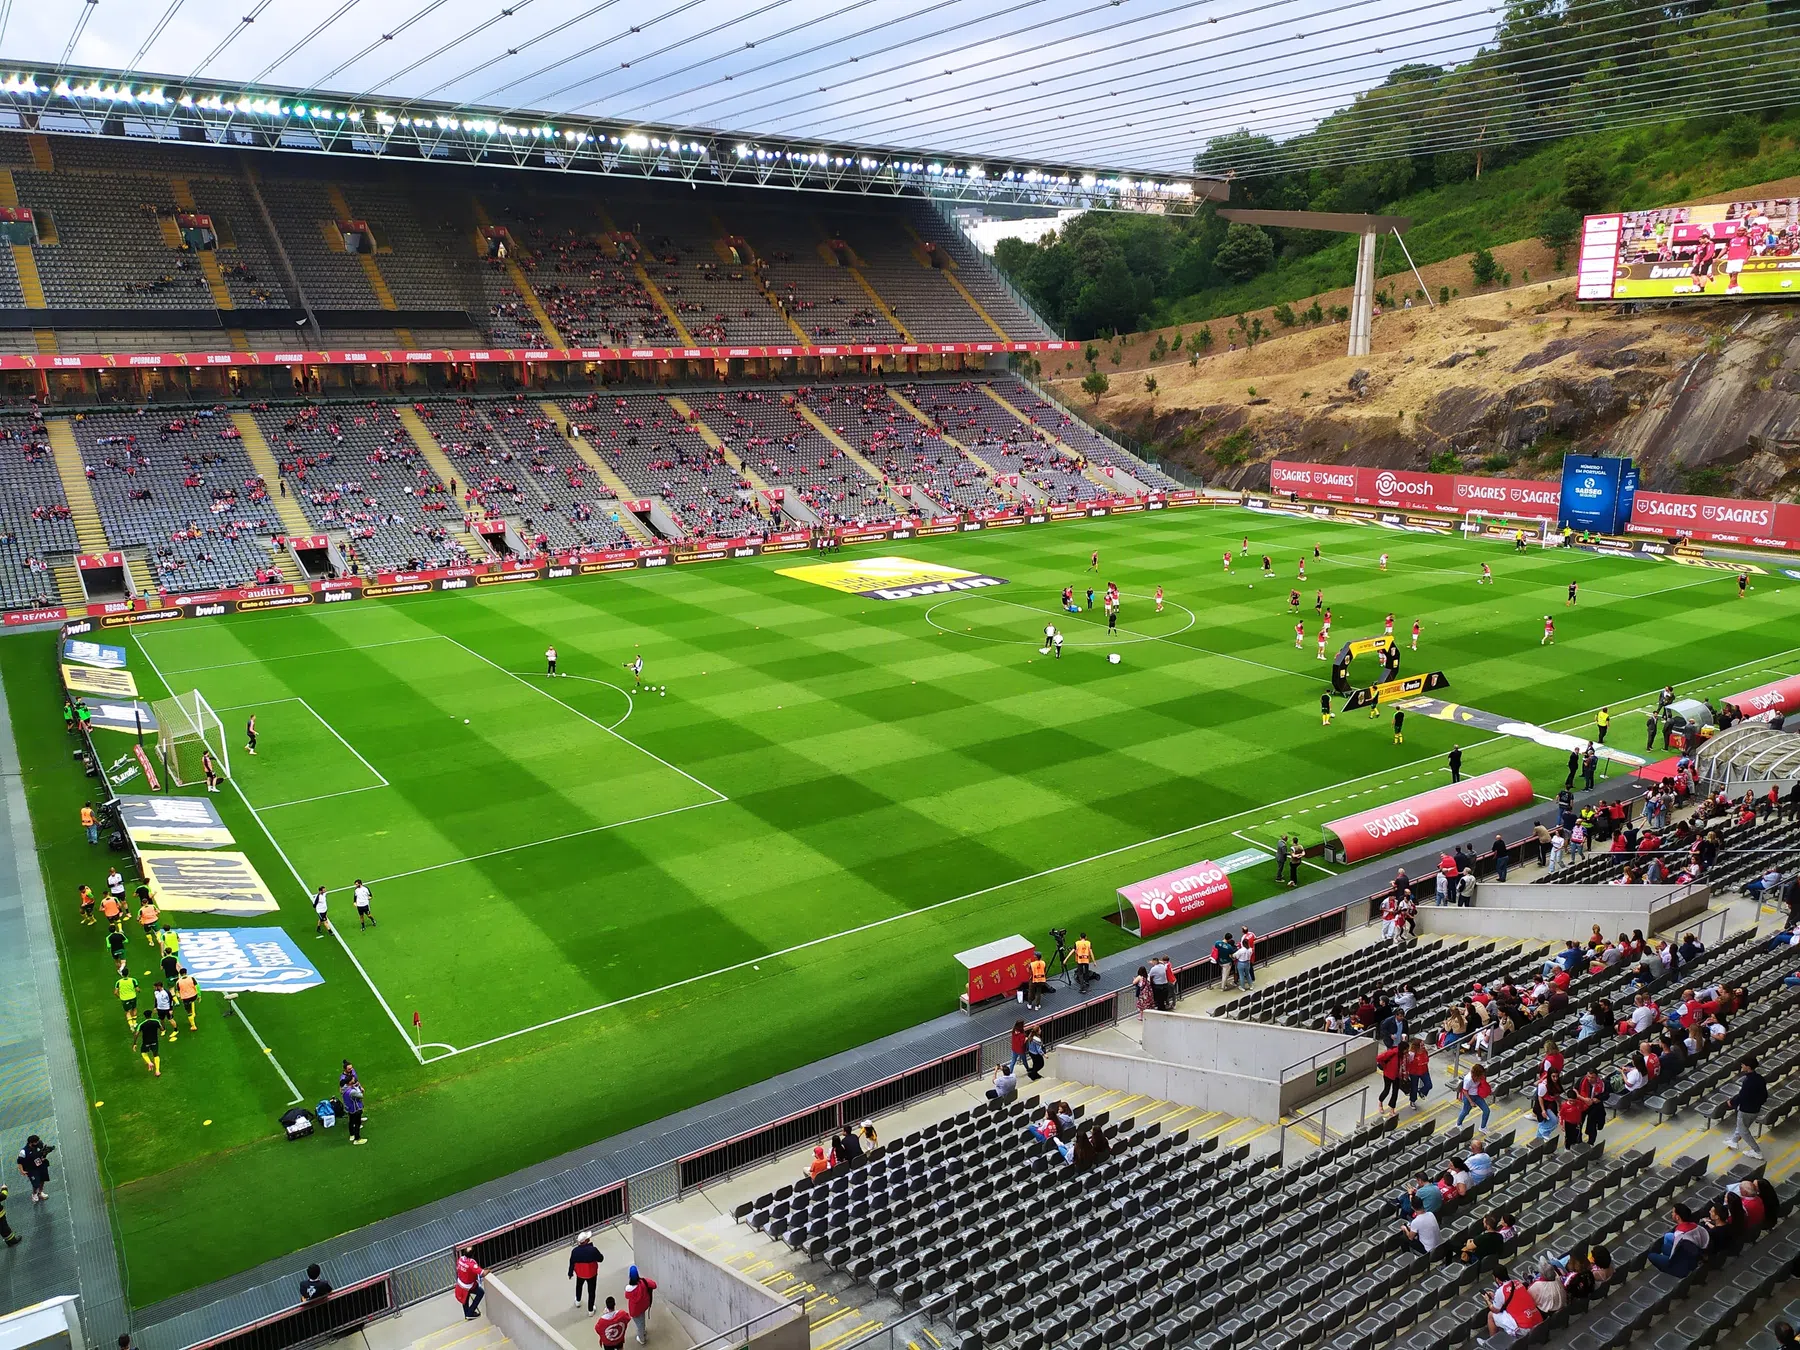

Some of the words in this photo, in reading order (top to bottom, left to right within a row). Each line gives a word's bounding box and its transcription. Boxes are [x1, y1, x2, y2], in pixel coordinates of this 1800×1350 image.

[1281, 469, 1311, 483] SAGRES
[1322, 472, 1354, 487] SAGRES
[1468, 485, 1507, 501] SAGRES
[1649, 500, 1698, 518] SAGRES
[1716, 505, 1769, 526] SAGRES
[735, 546, 754, 557] bwin
[1642, 543, 1665, 554] bwin
[646, 556, 667, 567] bwin
[549, 566, 572, 578] bwin
[442, 578, 467, 590] bwin
[873, 577, 1001, 600] bwin
[248, 587, 285, 598] auditiv
[325, 590, 352, 602] bwin
[196, 603, 225, 616] bwin
[22, 611, 60, 621] RE/MAX
[137, 612, 160, 621] nosso
[160, 611, 178, 619] jogo
[1405, 681, 1421, 691] bwin
[1759, 690, 1785, 709] SAGRES
[1471, 780, 1509, 806] SAGRES
[1376, 808, 1420, 836] SAGRES
[1170, 869, 1223, 894] amco
[1181, 899, 1205, 913] crédito
